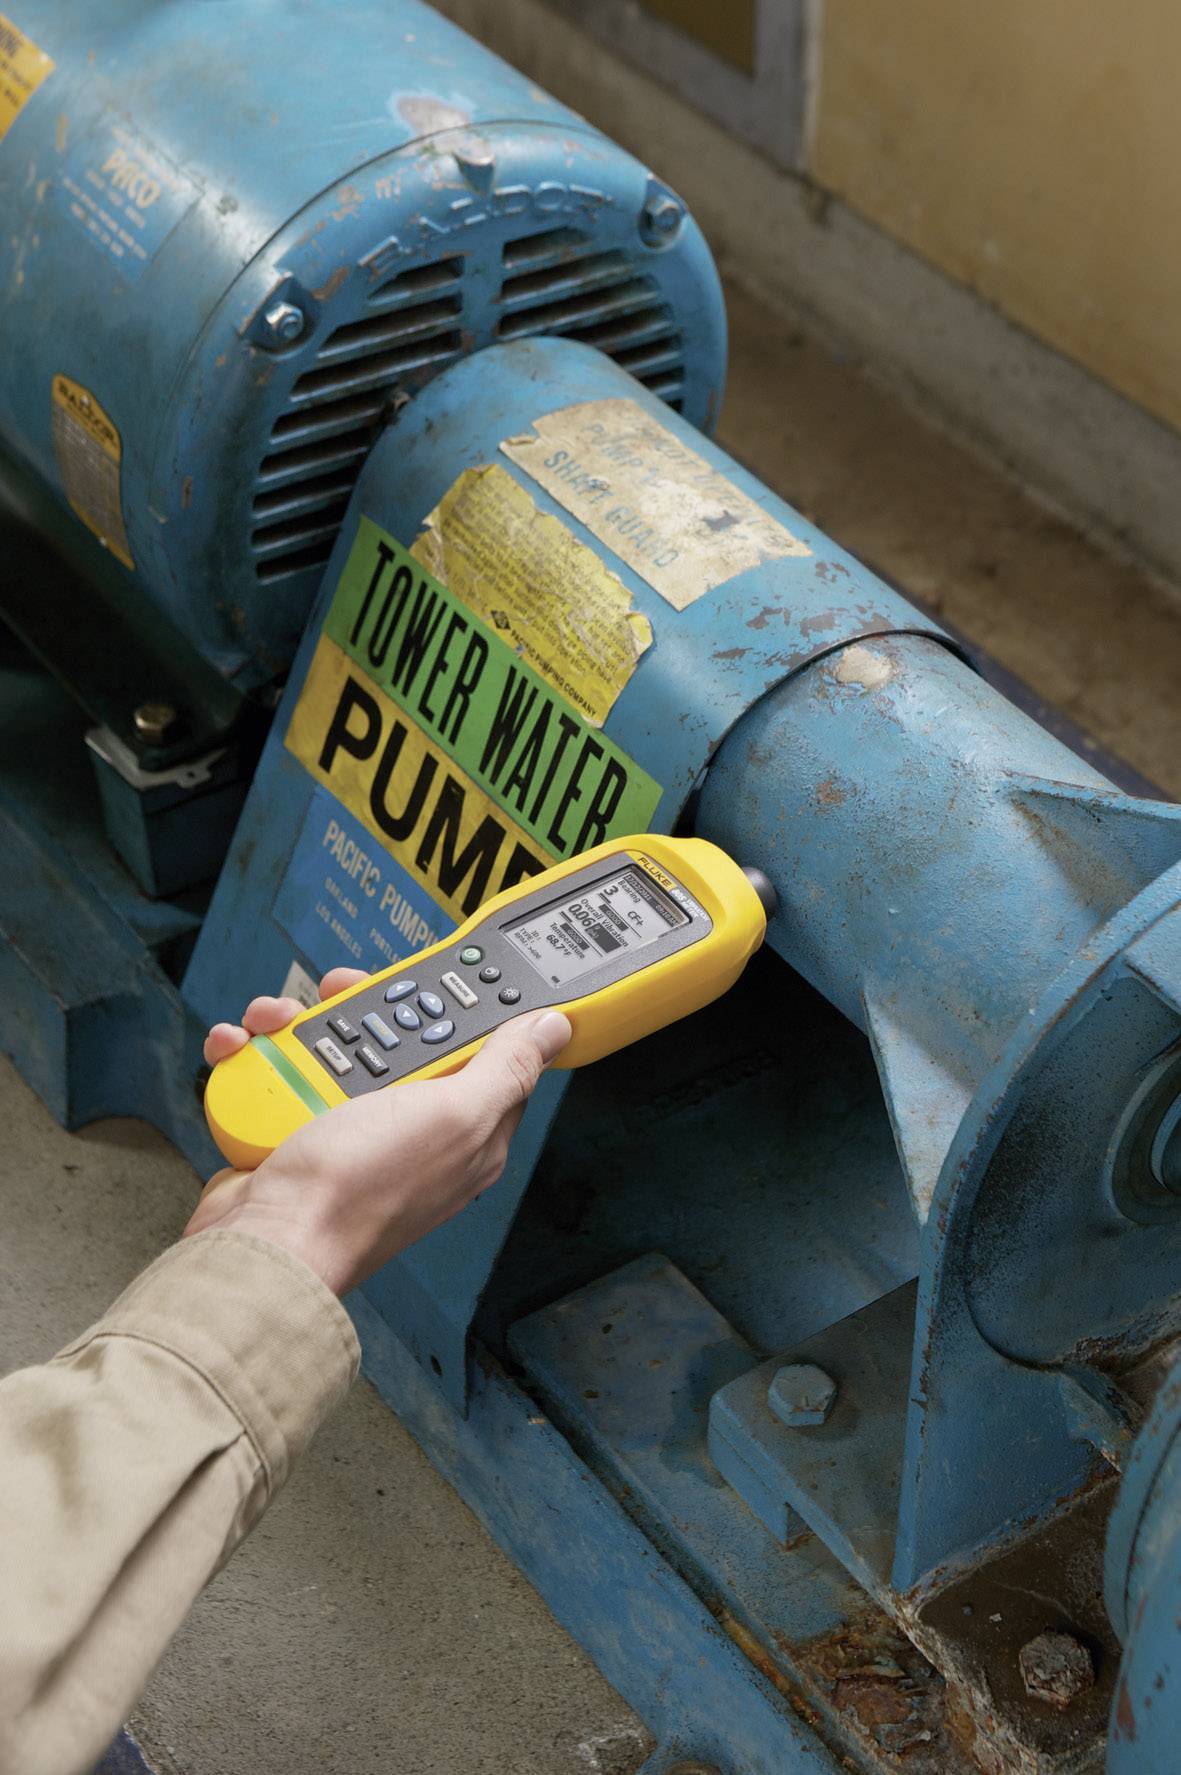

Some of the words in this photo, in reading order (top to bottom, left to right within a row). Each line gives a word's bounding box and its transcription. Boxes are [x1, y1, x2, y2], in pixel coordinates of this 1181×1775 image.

[349, 540, 490, 748] TOWER
[477, 664, 629, 860] WATER
[563, 682, 597, 718] COMPANY
[322, 819, 382, 898] PACIFIC
[638, 857, 673, 888] FLUKE
[604, 885, 619, 896] 3
[627, 911, 643, 926] CF+
[618, 879, 641, 903] Bearing
[568, 903, 596, 927] 0.06
[581, 898, 603, 920] Overall
[602, 919, 629, 947] Vibration
[550, 922, 585, 959] Temperature
[449, 975, 472, 999] MEASURE
[325, 1044, 342, 1061] SETUP
[336, 1018, 351, 1032] SAVE
[363, 1045, 383, 1069] MEMORY
